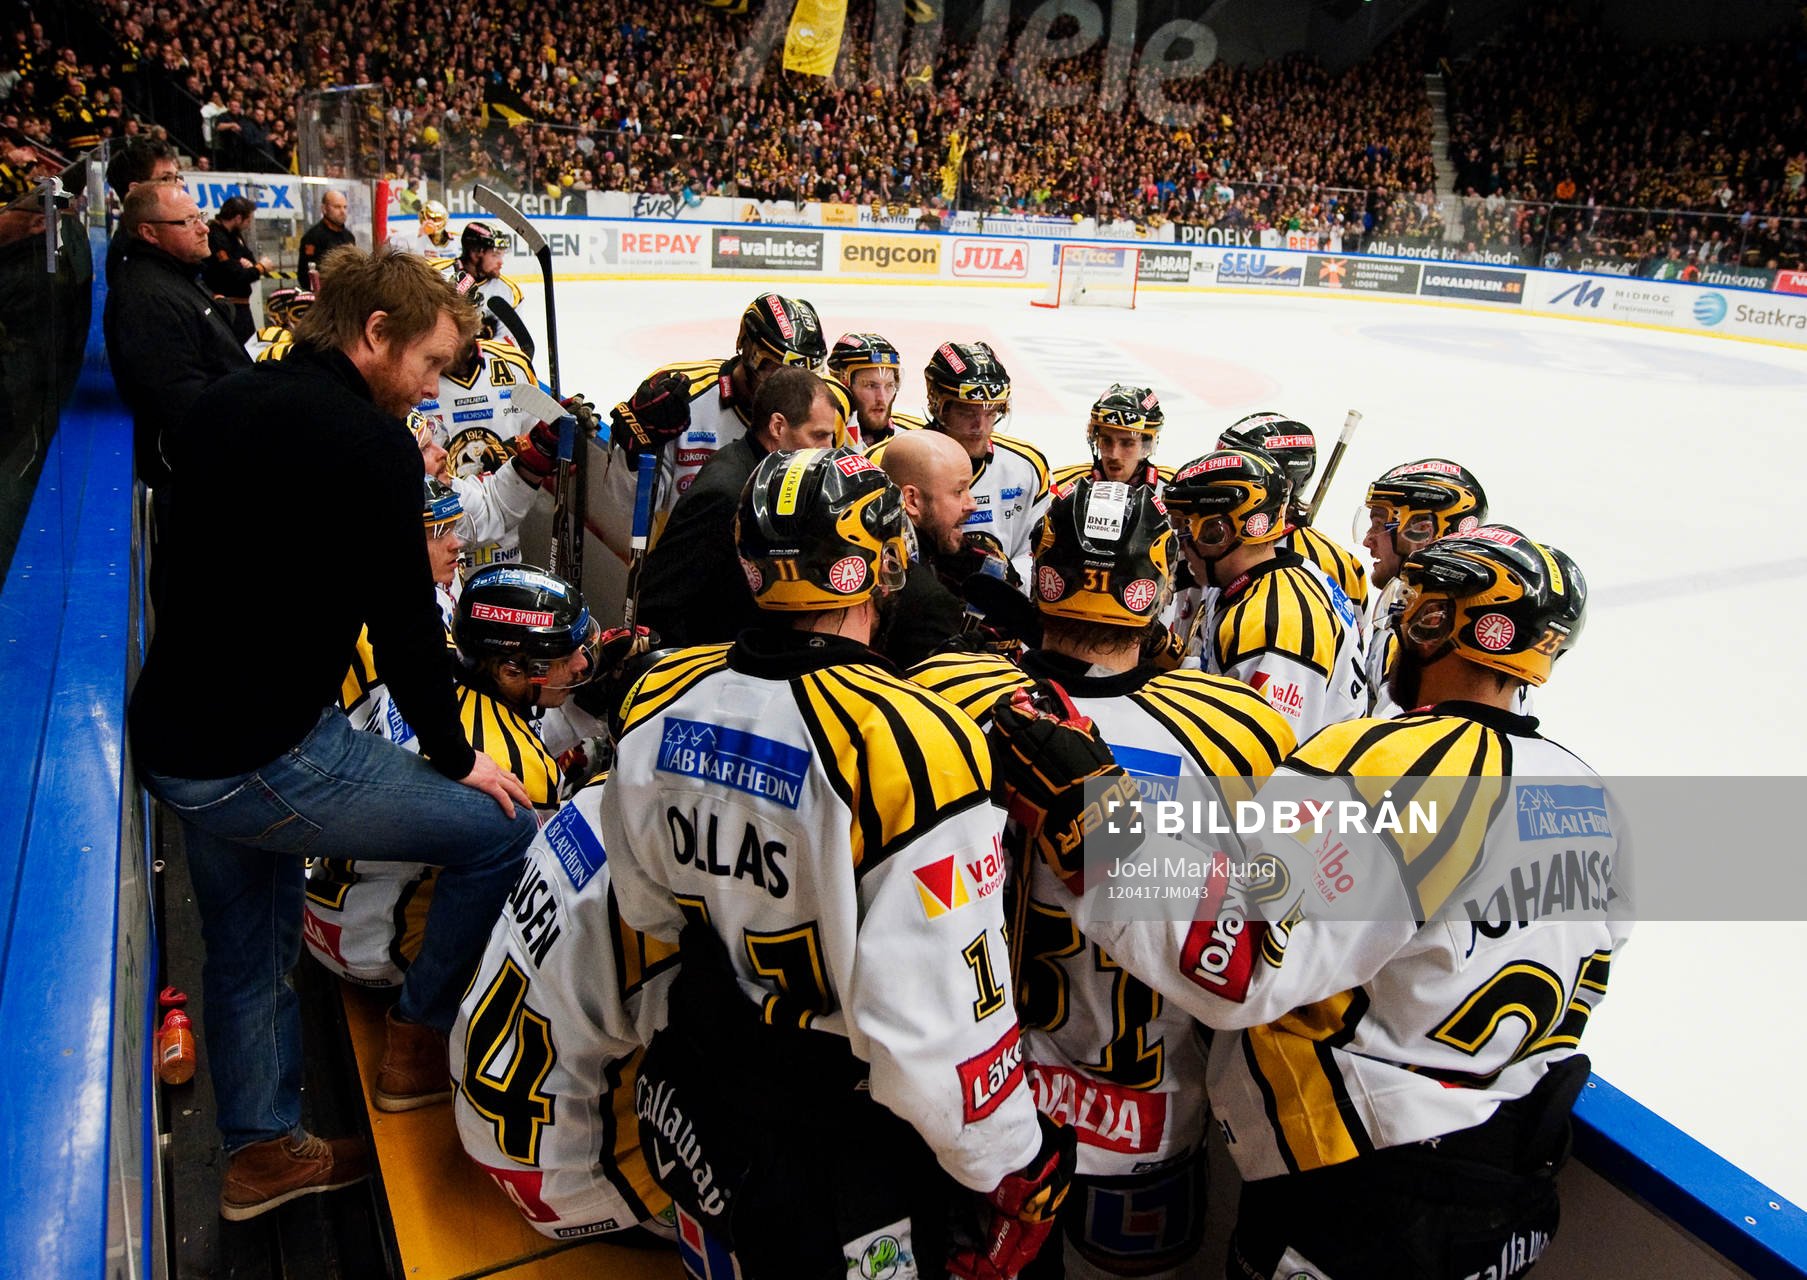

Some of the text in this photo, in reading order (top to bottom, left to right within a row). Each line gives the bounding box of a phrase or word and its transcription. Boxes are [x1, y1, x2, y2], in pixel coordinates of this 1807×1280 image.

[632, 195, 687, 220] EVRY
[621, 233, 702, 255] REPAY
[1181, 225, 1253, 247] PROFIX
[741, 238, 818, 258] valutec
[844, 244, 937, 268] engcon
[956, 247, 1025, 271] JULA
[1368, 241, 1395, 256] Alla
[1397, 243, 1439, 259] borde
[1153, 255, 1190, 272] ABRAB
[1219, 252, 1266, 275] SEU
[1425, 274, 1521, 294] LOKALDELEN.SE
[1676, 265, 1768, 289] rtinsons
[1615, 290, 1671, 303] MIDROC
[490, 358, 516, 387] A
[465, 430, 484, 441] 1912
[1267, 436, 1294, 447] TEAM
[1209, 457, 1241, 469] SPORTIA
[1086, 524, 1110, 533] NORDIC
[1087, 515, 1110, 526] BNT
[774, 559, 799, 581] 11
[1083, 568, 1111, 592] 31
[475, 605, 551, 626] TEAM SPORTIA
[1533, 629, 1565, 656] 25
[669, 749, 799, 805] AB KAR HEDIN
[666, 805, 790, 899] OLLAS
[635, 1073, 725, 1216] Callaway
[559, 1219, 616, 1238] BAUER
